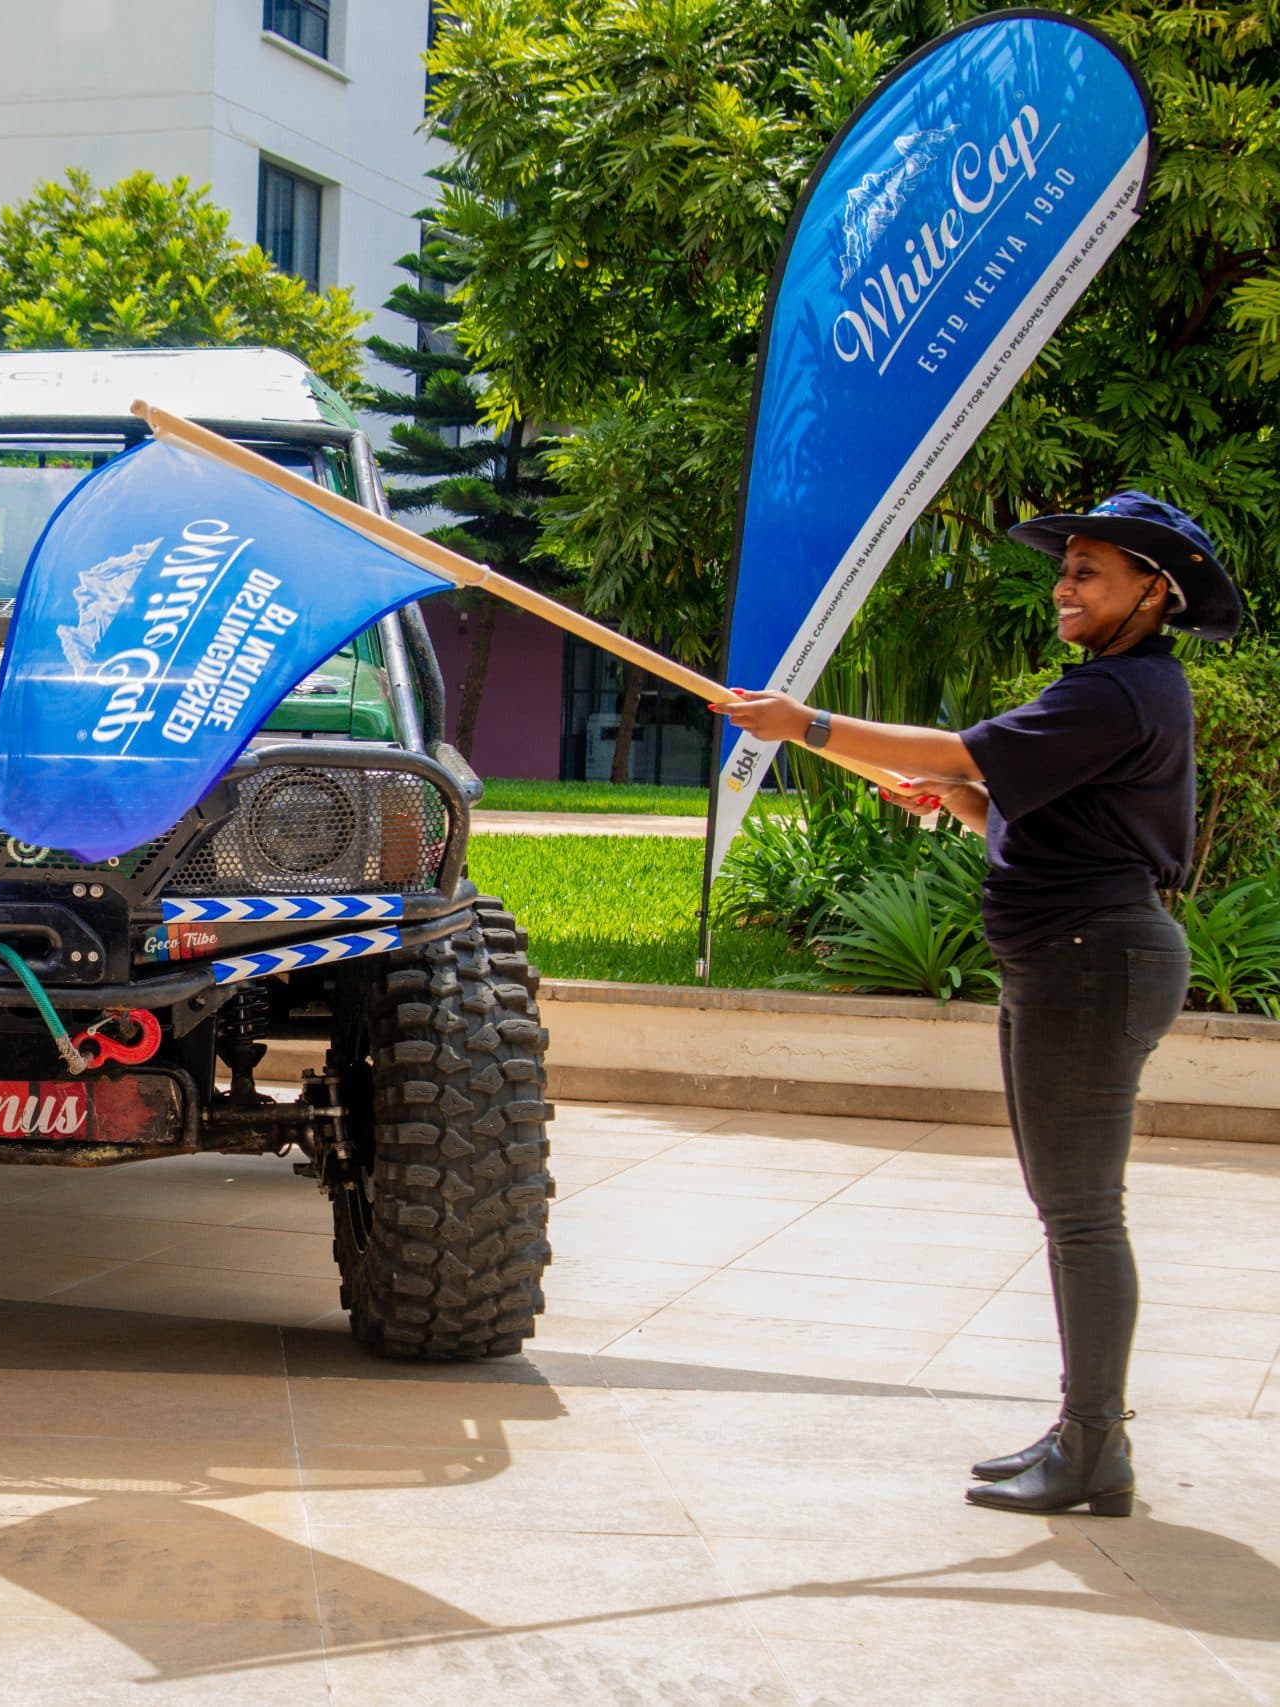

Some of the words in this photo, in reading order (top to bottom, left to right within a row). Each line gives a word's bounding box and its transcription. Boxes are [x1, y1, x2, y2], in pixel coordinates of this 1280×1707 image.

[833, 207, 965, 364] White
[951, 104, 1040, 216] Cap
[917, 314, 968, 374] ESTD
[964, 235, 1027, 309] KENYA
[1025, 168, 1075, 226] 1950
[786, 639, 816, 686] ALCOHOL
[813, 567, 859, 638] CONSUMPTION
[856, 556, 866, 568] IS
[863, 513, 896, 558] HARMFUL
[893, 497, 906, 512] TO
[904, 470, 926, 496] YOUR
[952, 409, 969, 430] NOT
[968, 388, 984, 410] FOR
[982, 364, 1002, 389] SALE
[998, 350, 1012, 366] TO
[1009, 307, 1044, 351] PERSONS
[1041, 275, 1068, 307] UNDER
[1065, 255, 1083, 275] THE
[1080, 236, 1099, 257] AGE
[1095, 220, 1108, 235] OF
[1106, 210, 1118, 221] 18
[731, 748, 758, 781] kbl
[144, 936, 179, 953] Geco
[183, 932, 218, 948] Tribe
